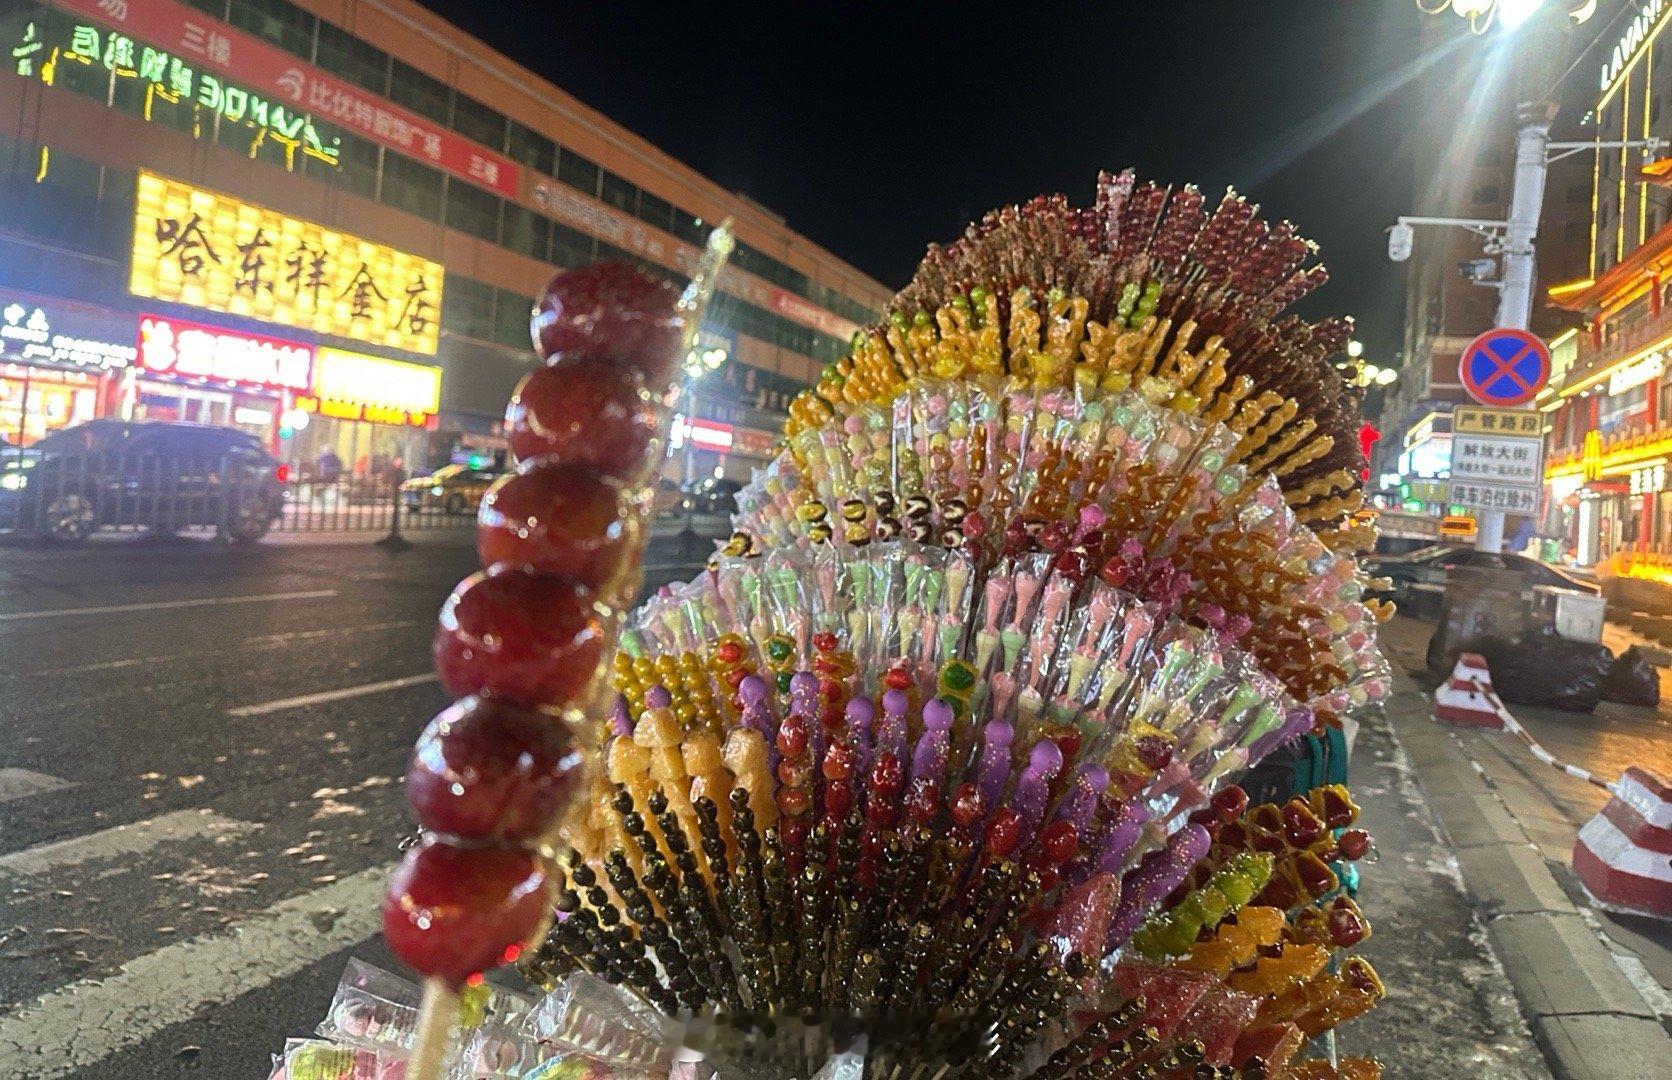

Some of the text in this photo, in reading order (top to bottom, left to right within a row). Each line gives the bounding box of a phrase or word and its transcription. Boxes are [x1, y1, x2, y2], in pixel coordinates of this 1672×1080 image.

[1459, 412, 1538, 431] 严管路段
[1464, 443, 1529, 461] 解放大街
[1453, 485, 1533, 511] 停车泊位除外
